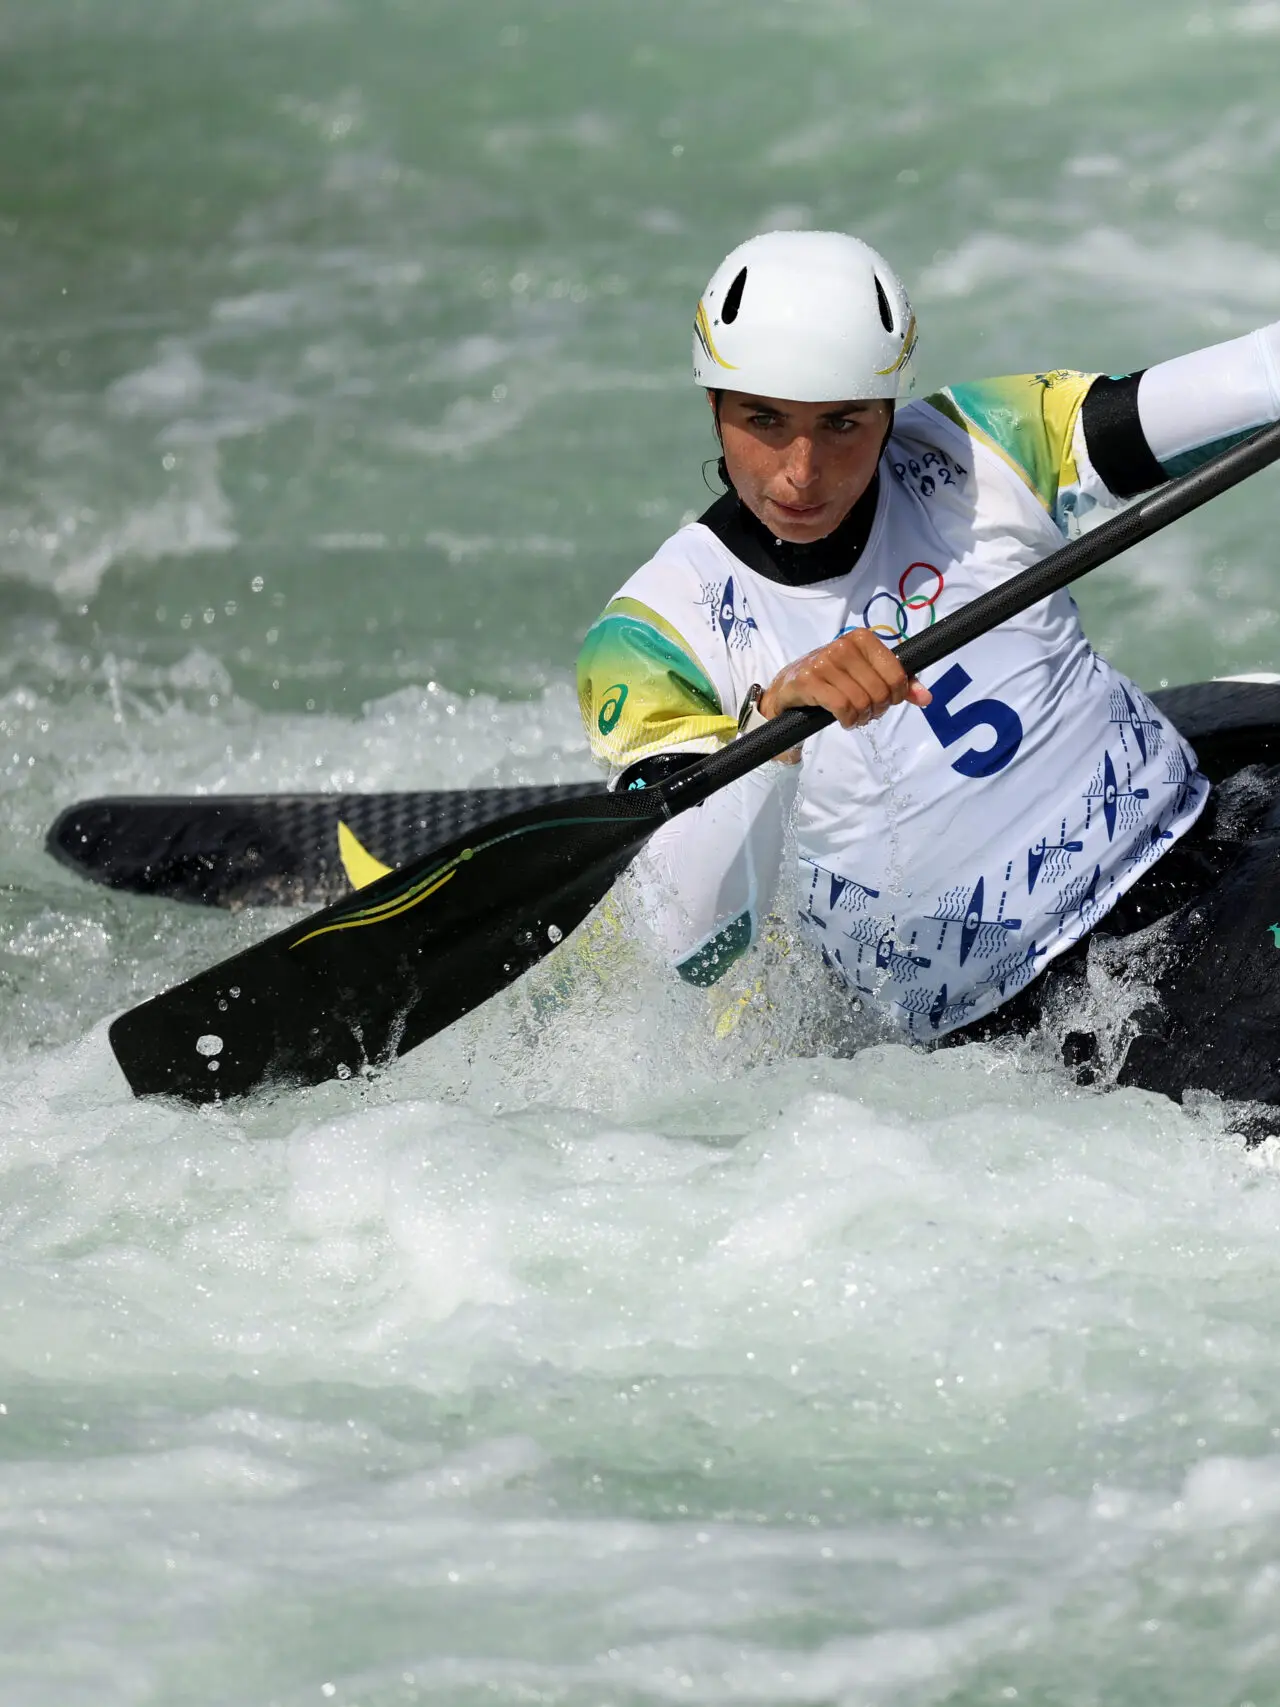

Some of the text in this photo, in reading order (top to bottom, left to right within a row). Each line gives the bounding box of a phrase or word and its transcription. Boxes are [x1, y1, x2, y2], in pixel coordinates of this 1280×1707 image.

[894, 450, 949, 480] PARI
[915, 463, 967, 497] 024
[921, 662, 1024, 779] 5
